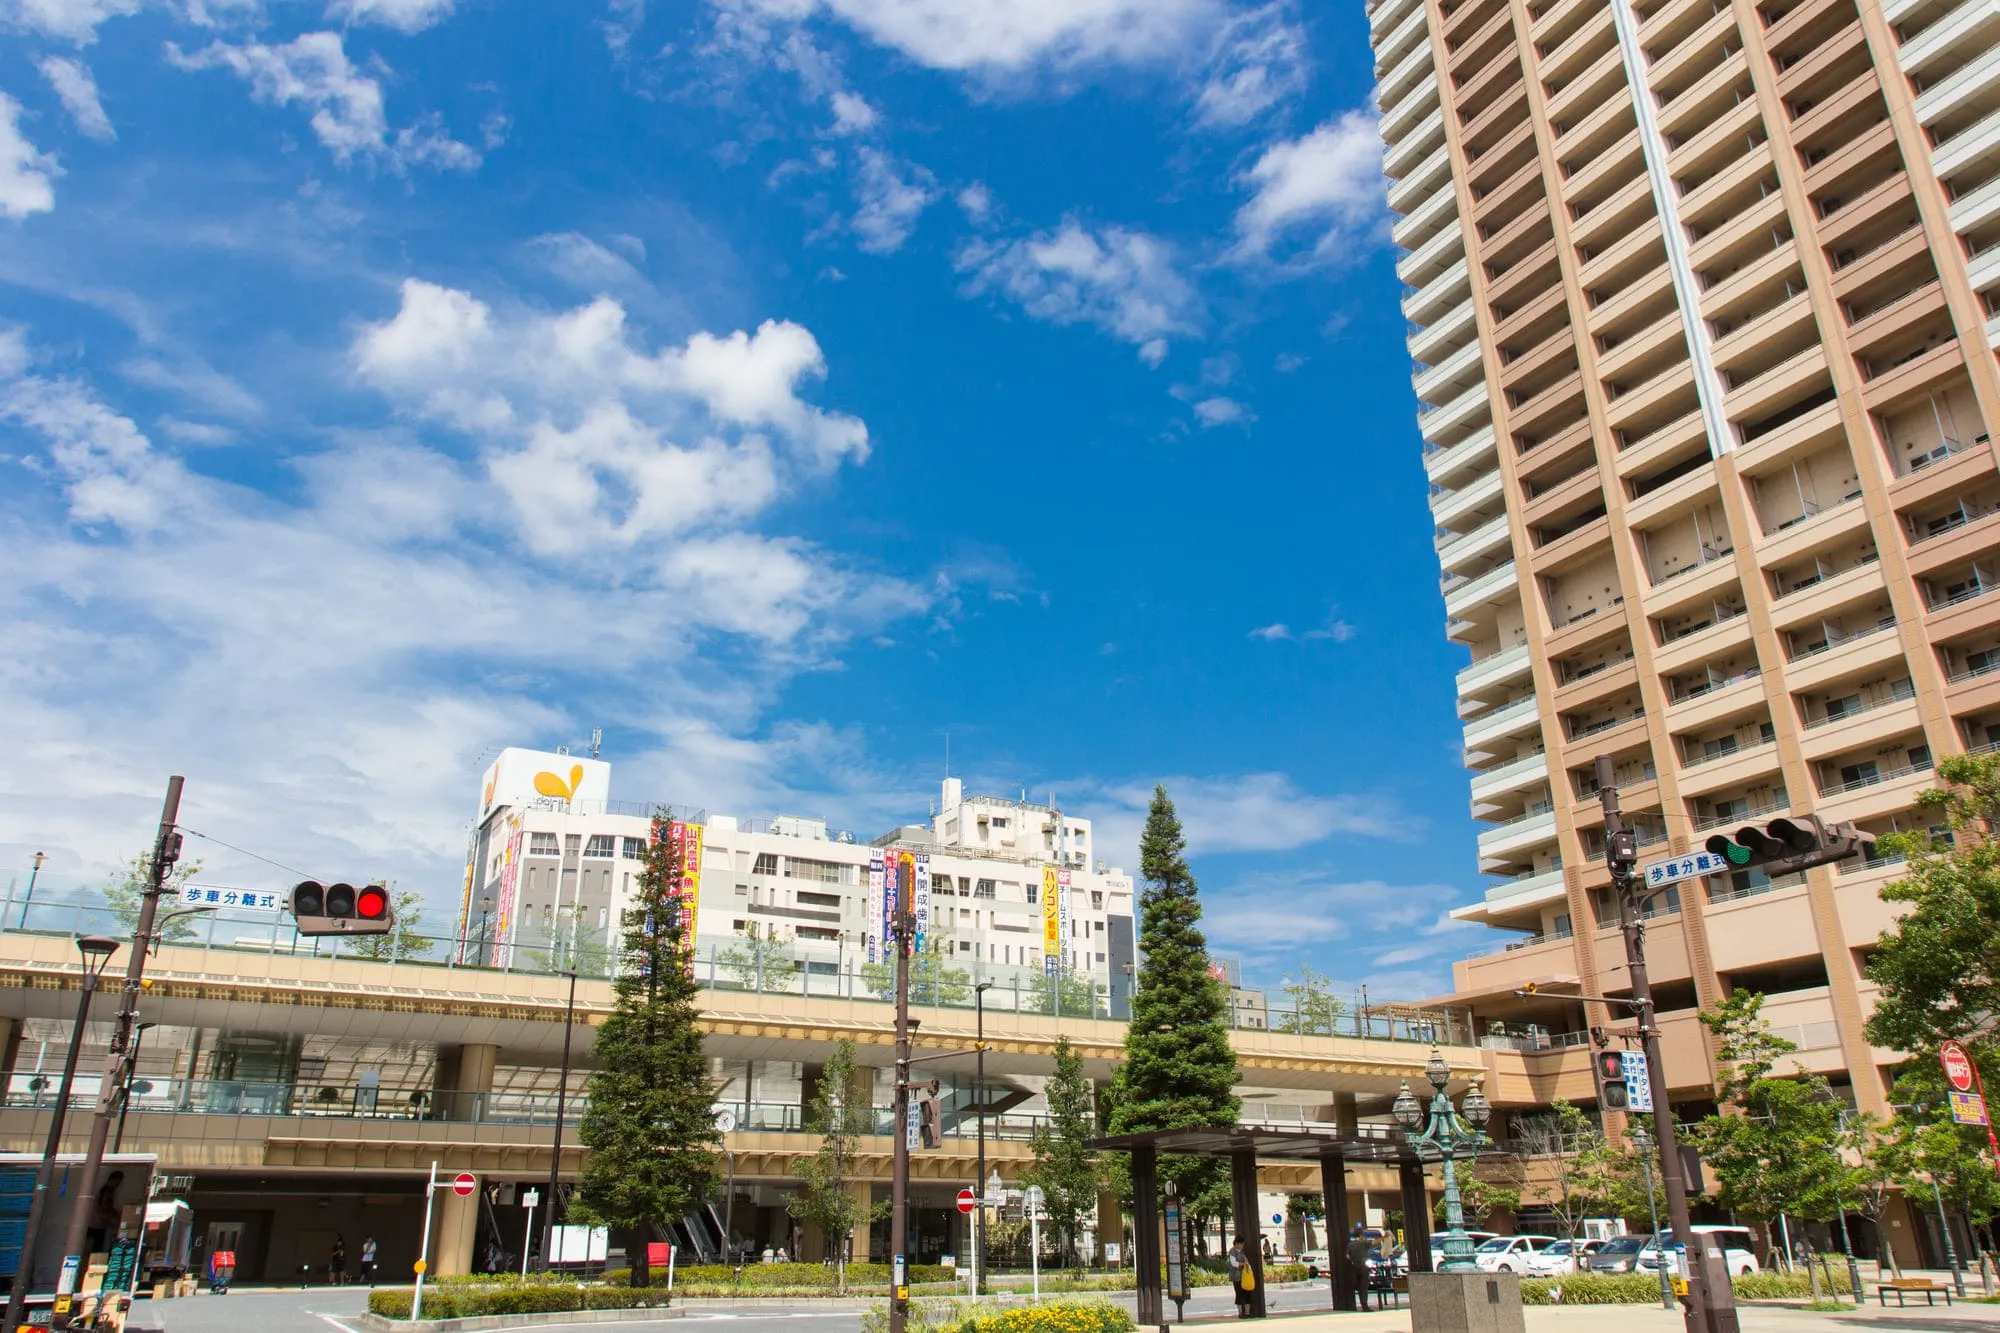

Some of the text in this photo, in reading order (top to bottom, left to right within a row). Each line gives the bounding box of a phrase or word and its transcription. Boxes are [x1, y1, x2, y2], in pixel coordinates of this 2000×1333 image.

[686, 828, 698, 873] 山内農場
[916, 855, 929, 863] 11F
[1651, 854, 1726, 882] 歩車分離式
[187, 888, 275, 907] 歩車分離式
[683, 877, 695, 903] 魚民
[917, 879, 928, 933] 開成歯科
[1638, 1057, 1651, 1106] 押ボタン式
